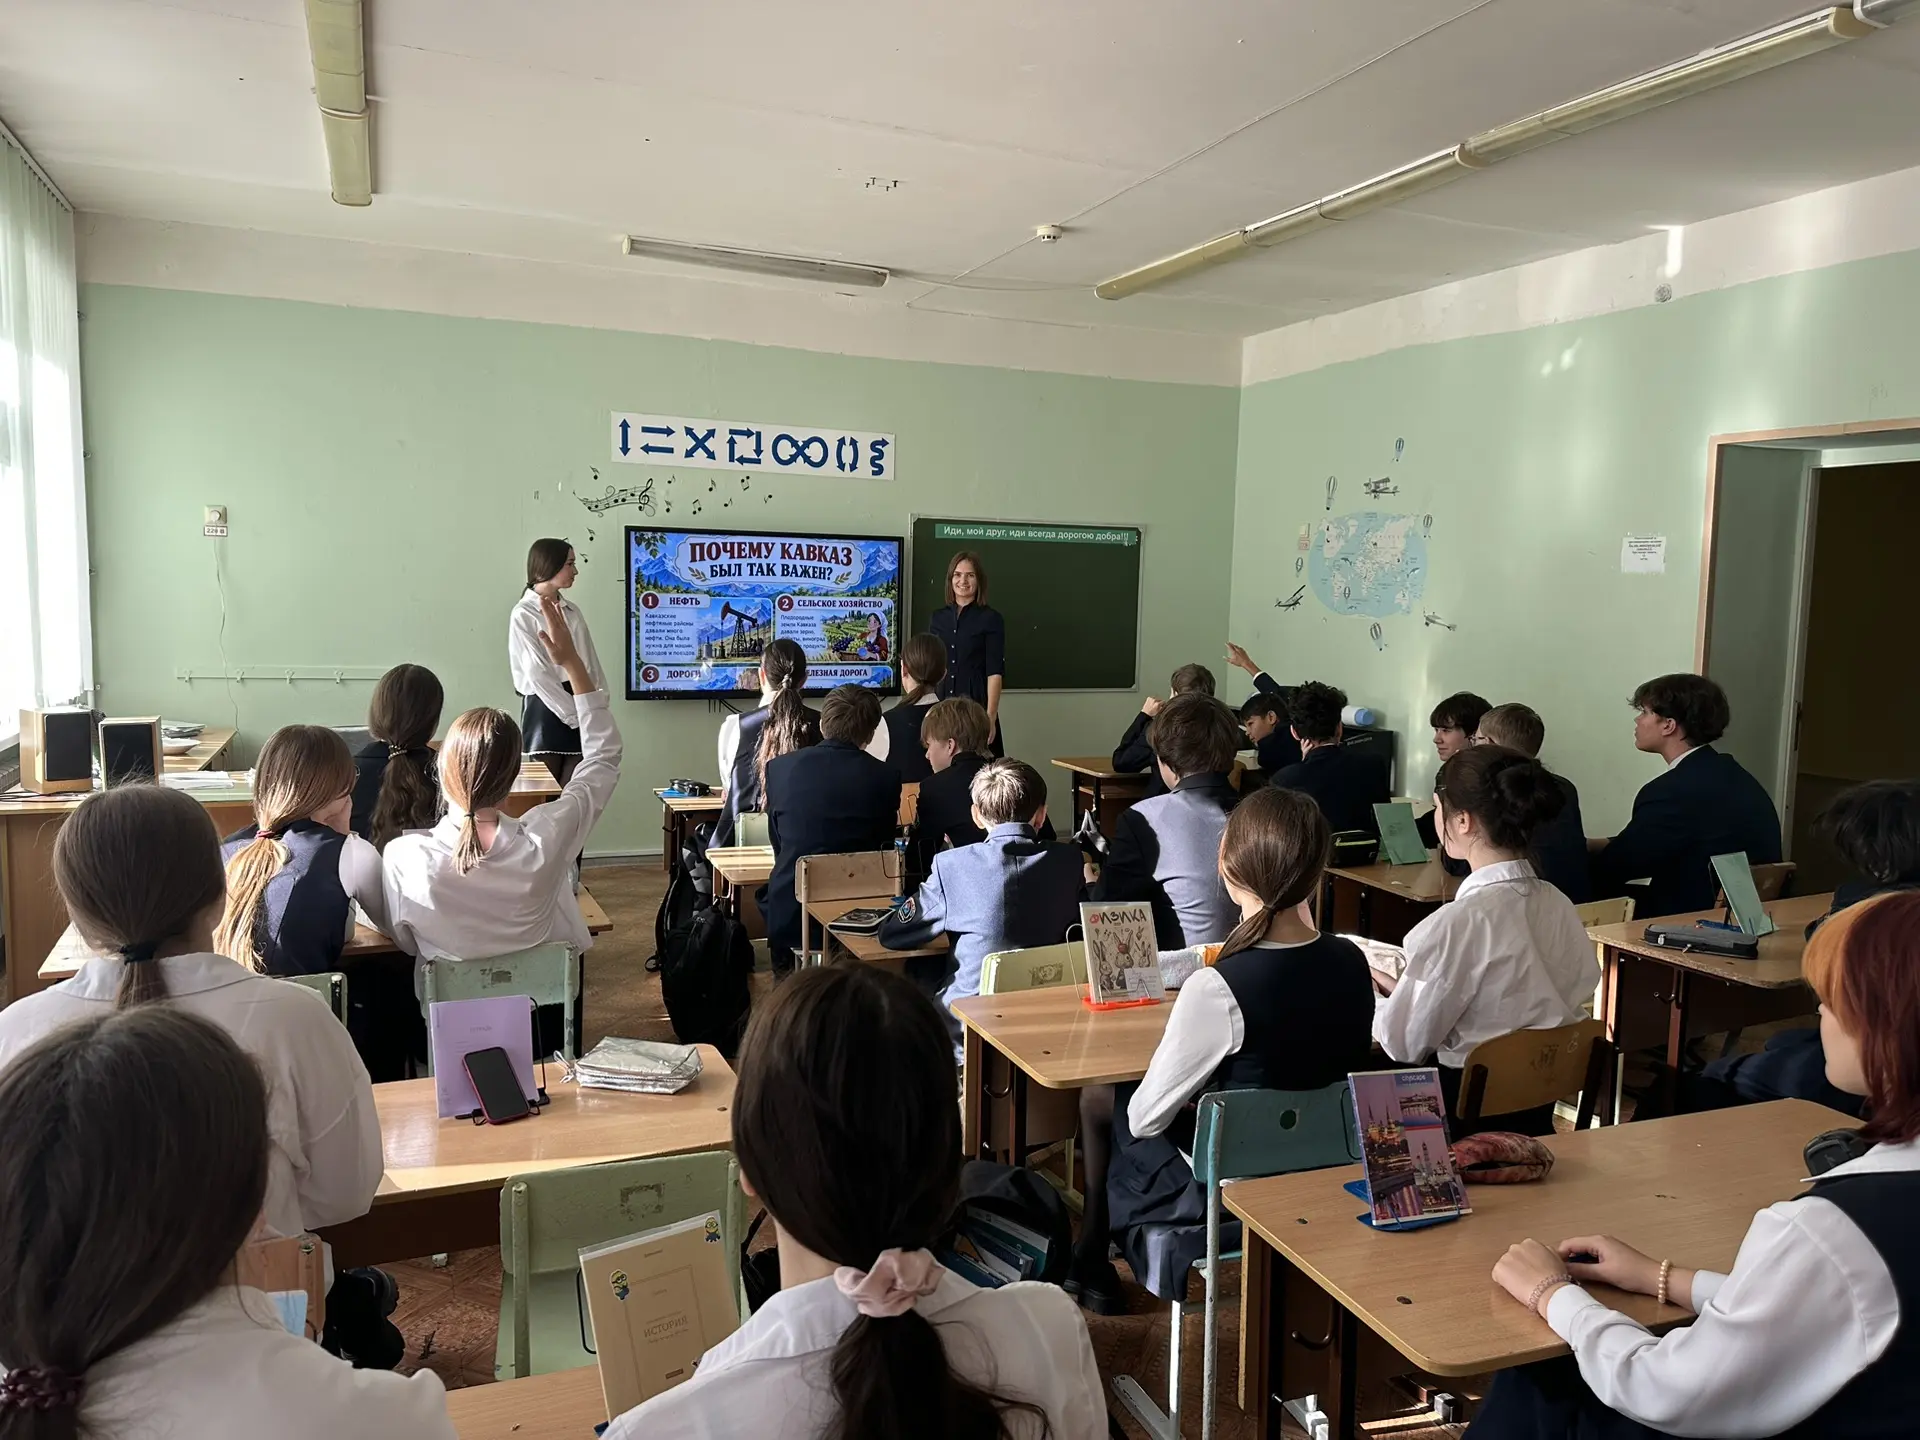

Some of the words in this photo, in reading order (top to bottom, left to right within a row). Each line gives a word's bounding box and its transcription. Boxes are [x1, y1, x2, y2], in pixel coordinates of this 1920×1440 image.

[943, 526, 964, 536] Иди,
[966, 527, 984, 536] мой
[985, 528, 1006, 538] друг,
[1009, 529, 1026, 538] иди
[1028, 530, 1056, 540] всегда
[1057, 531, 1094, 541] дорогою
[688, 541, 775, 563] ПОЧЕМУ
[780, 542, 853, 567] КАВКАЗ
[709, 562, 743, 578] БЫЛ
[746, 562, 777, 577] ТАК
[780, 563, 833, 581] ВАЖЕН?
[646, 595, 654, 607] 1
[669, 596, 701, 606] НЕФТЬ
[781, 597, 790, 609] 2
[797, 599, 837, 608] СЕЛЬСКОЕ
[838, 599, 883, 609] ХОЗЯЙСТВО
[646, 669, 655, 680] 3
[666, 669, 702, 679] ДОРОГИ
[806, 668, 838, 677] ЕЛЕЗНАЯ
[839, 669, 868, 678] ДОРОГА
[1090, 908, 1148, 924] ФИЗИКА
[1402, 1074, 1426, 1082] cityscape
[642, 1315, 689, 1339] ИСТОРИЯ
